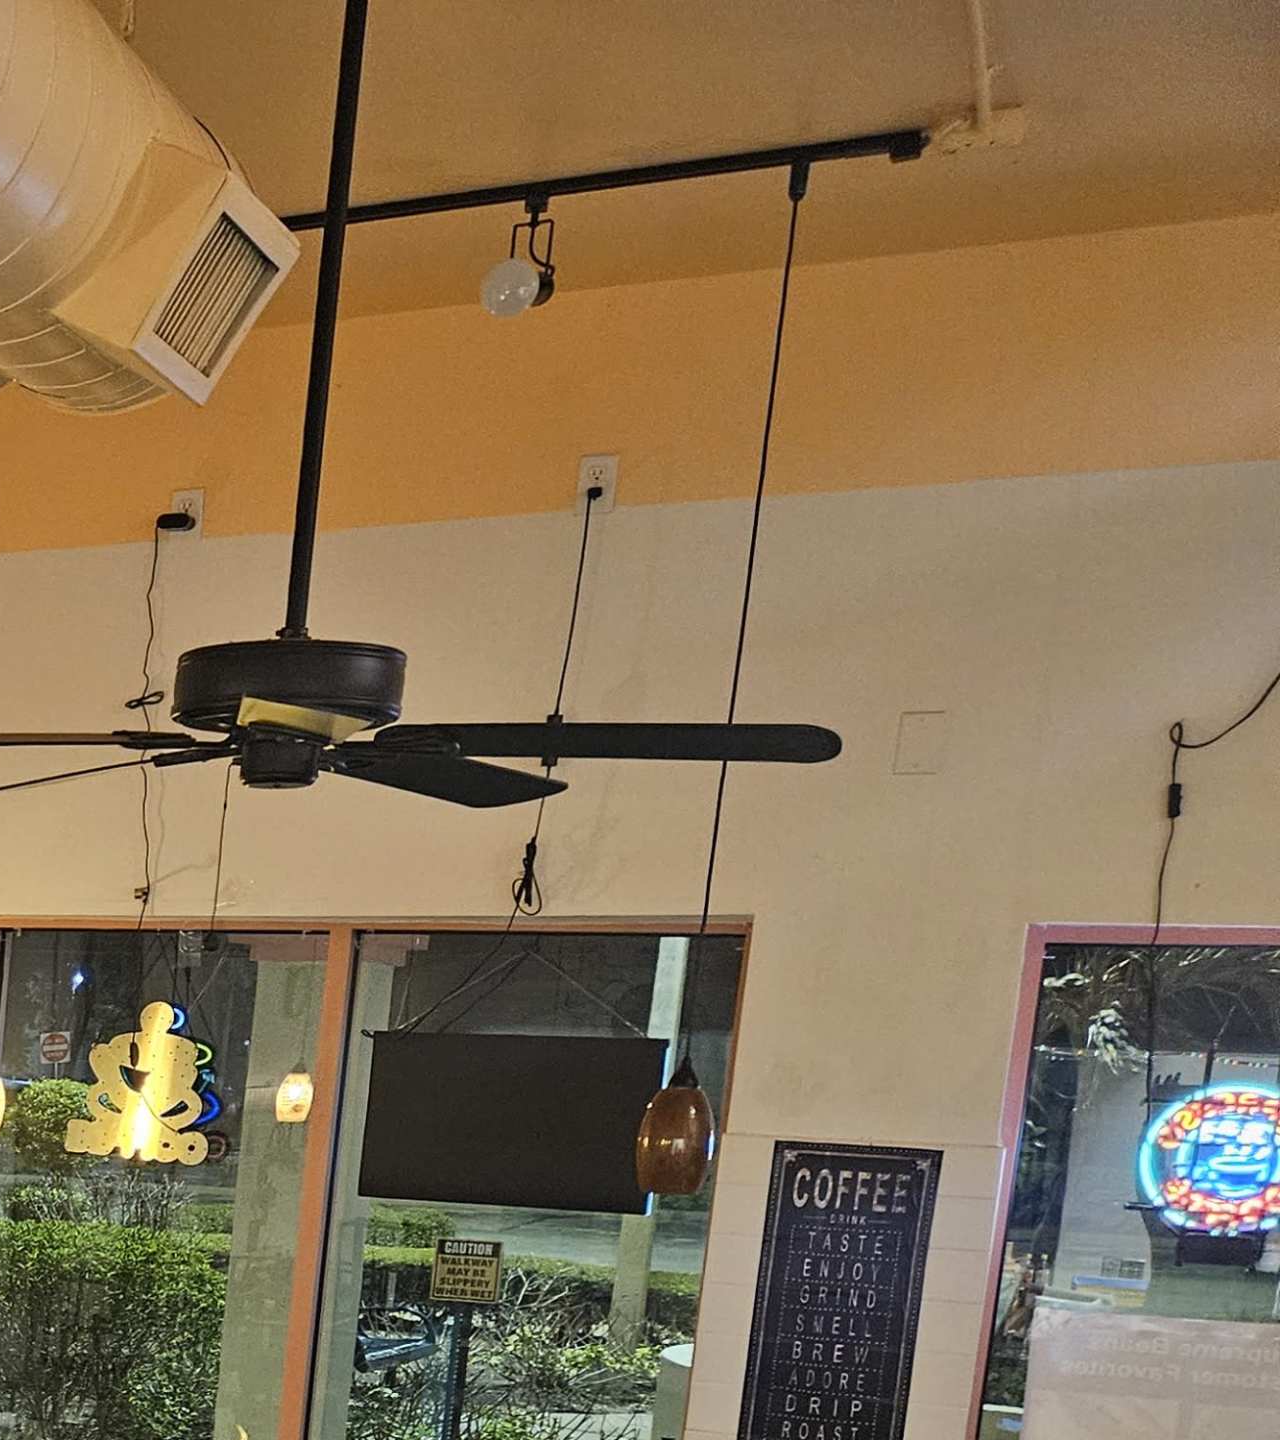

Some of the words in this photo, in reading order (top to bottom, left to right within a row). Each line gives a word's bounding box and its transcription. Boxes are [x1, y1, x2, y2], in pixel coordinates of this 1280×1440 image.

[793, 1167, 911, 1213] COFFEE
[829, 1213, 867, 1225] DRINK
[444, 1241, 494, 1255] CAUTION
[808, 1232, 884, 1255] TASTE
[440, 1256, 494, 1267] WALKWAY
[446, 1267, 471, 1277] MAY
[473, 1268, 486, 1277] BE
[803, 1258, 881, 1283] ENJOY
[435, 1287, 468, 1297] WHEN
[470, 1289, 493, 1298] WET
[438, 1277, 491, 1288] SLIPPERY
[800, 1285, 877, 1309] GRIND
[796, 1314, 872, 1337] SMELL
[792, 1340, 869, 1364] BREW
[788, 1368, 865, 1392] ADORE
[785, 1394, 862, 1418] DRIP
